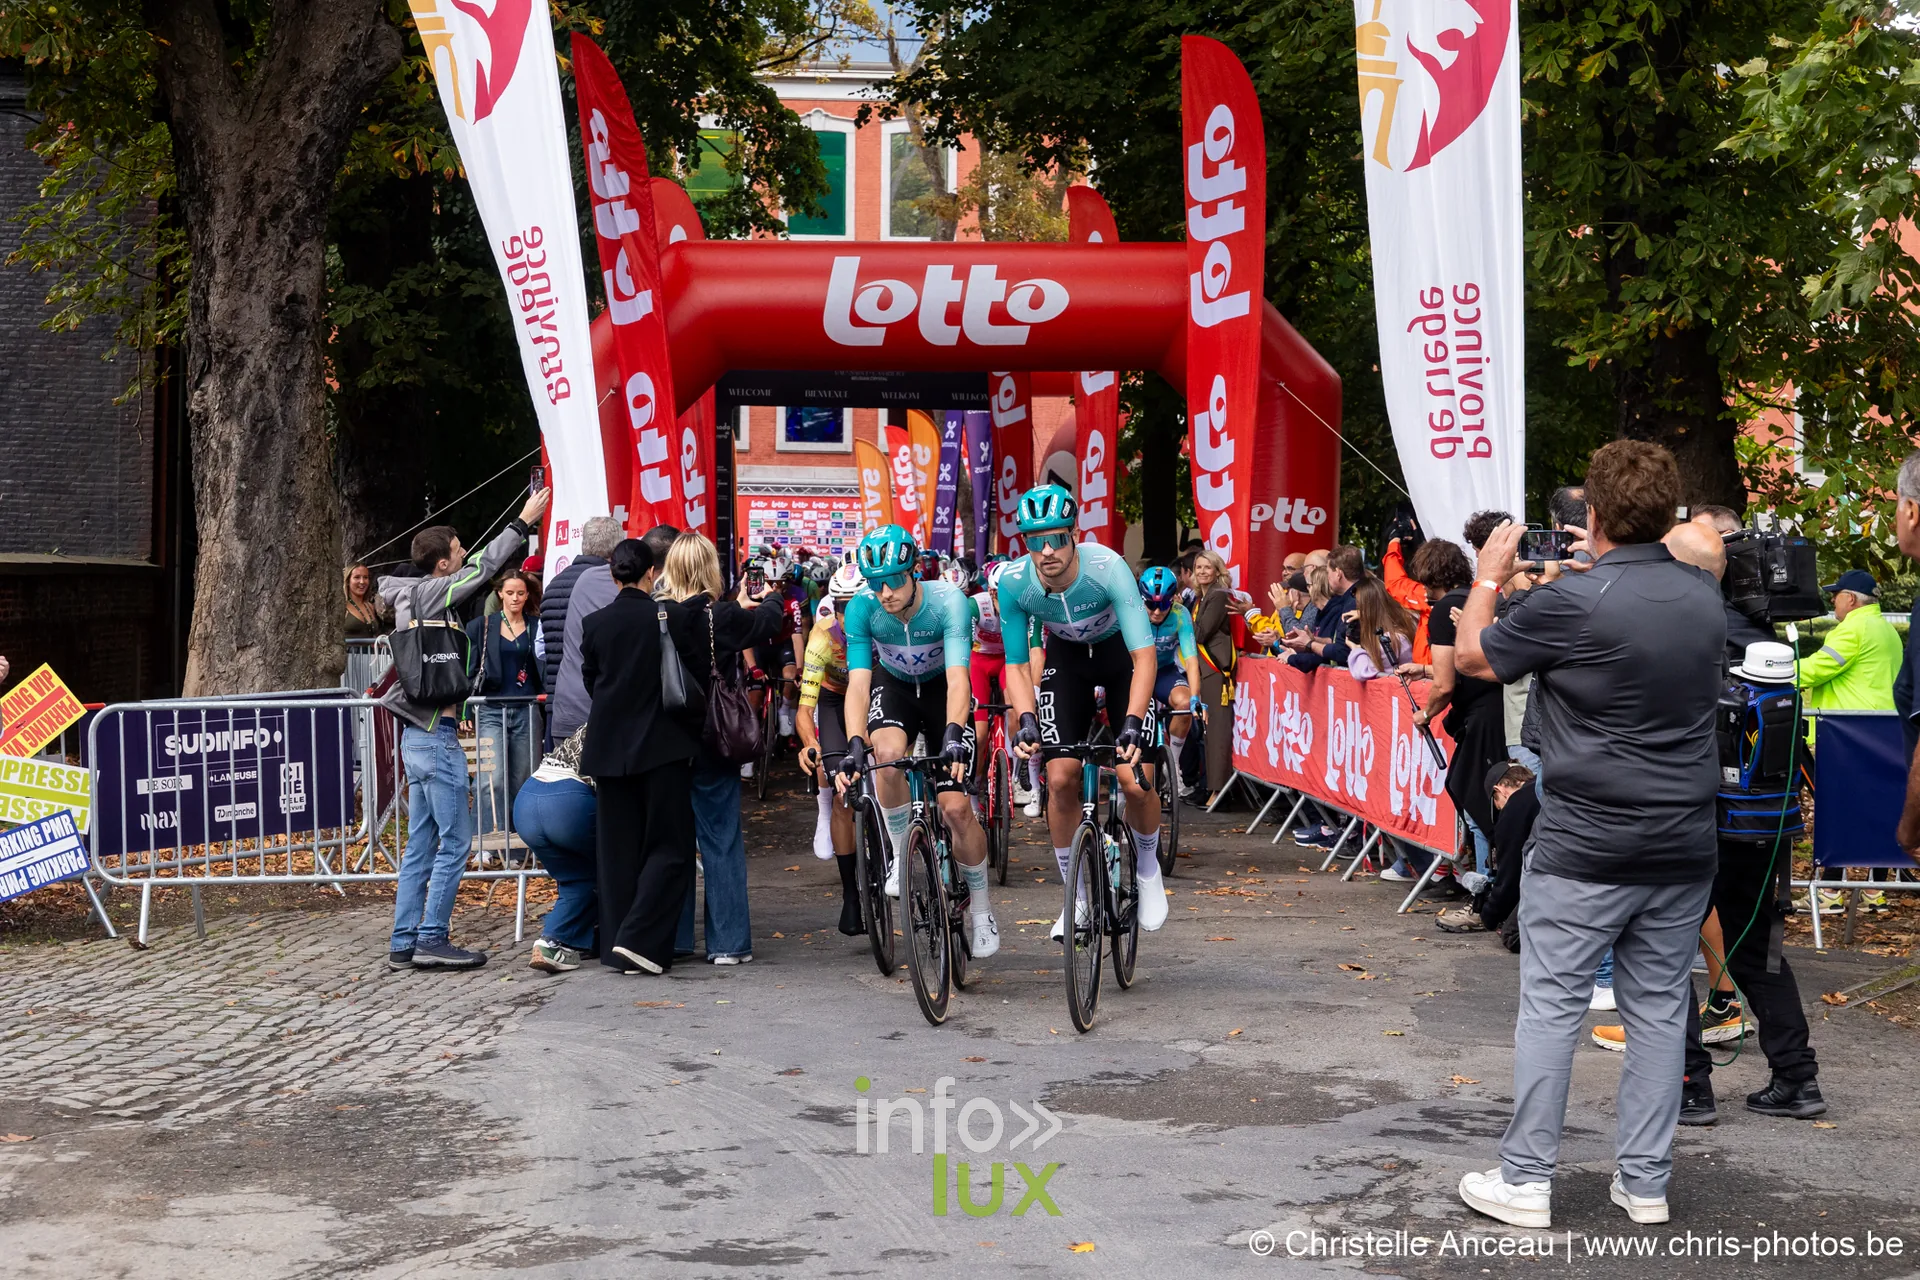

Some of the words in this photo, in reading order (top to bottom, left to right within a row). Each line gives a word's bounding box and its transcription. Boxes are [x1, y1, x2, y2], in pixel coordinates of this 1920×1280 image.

[823, 256, 1070, 346] lotto
[728, 388, 773, 397] WELCOME
[804, 389, 849, 398] BIENVENUE
[881, 391, 920, 399] WELKOM
[1073, 601, 1098, 613] BEAT
[882, 646, 944, 666] SAXO
[1, 686, 37, 728] KING
[28, 669, 55, 698] VIP
[21, 695, 81, 748] PARKING
[1040, 691, 1060, 744] BEAT
[1265, 672, 1313, 774] lotto
[165, 728, 270, 756] SUDINFO
[1325, 685, 1374, 802] lotto
[161, 777, 184, 790] SOIR
[40, 814, 75, 843] PMR
[140, 811, 180, 831] max
[26, 848, 88, 887] PARKING
